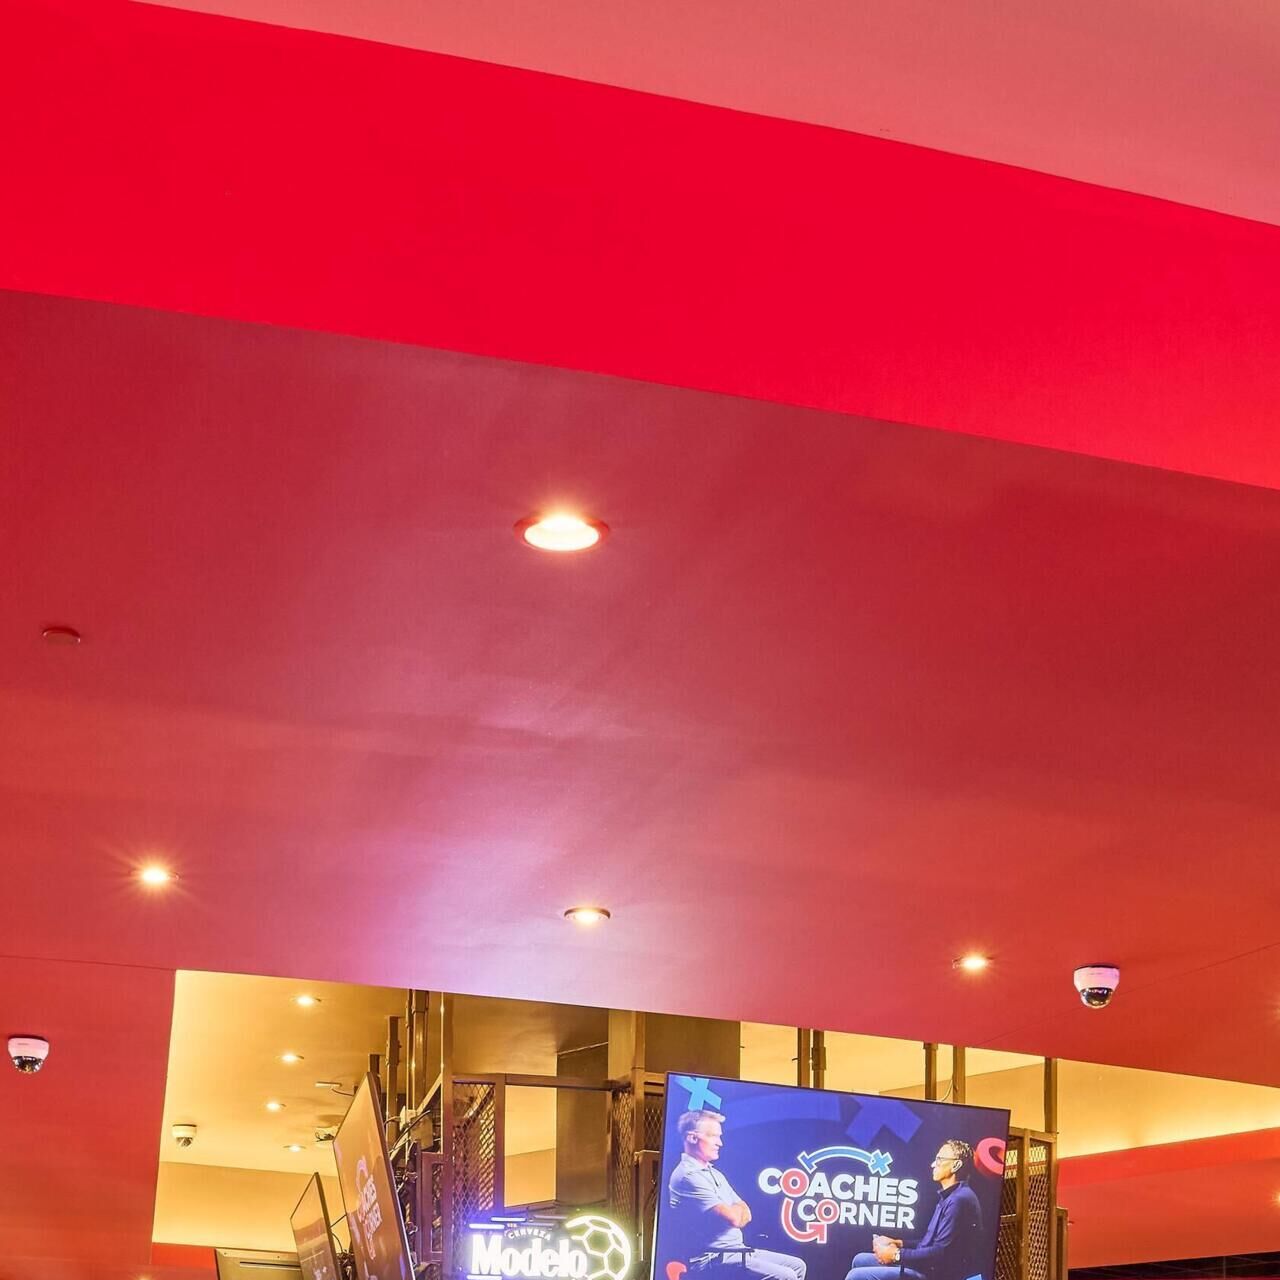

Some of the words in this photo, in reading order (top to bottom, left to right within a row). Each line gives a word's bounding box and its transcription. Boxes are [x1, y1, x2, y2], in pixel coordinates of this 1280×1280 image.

[758, 1167, 919, 1206] COACHES
[797, 1199, 915, 1230] CORNER
[472, 1233, 588, 1279] Modelo
